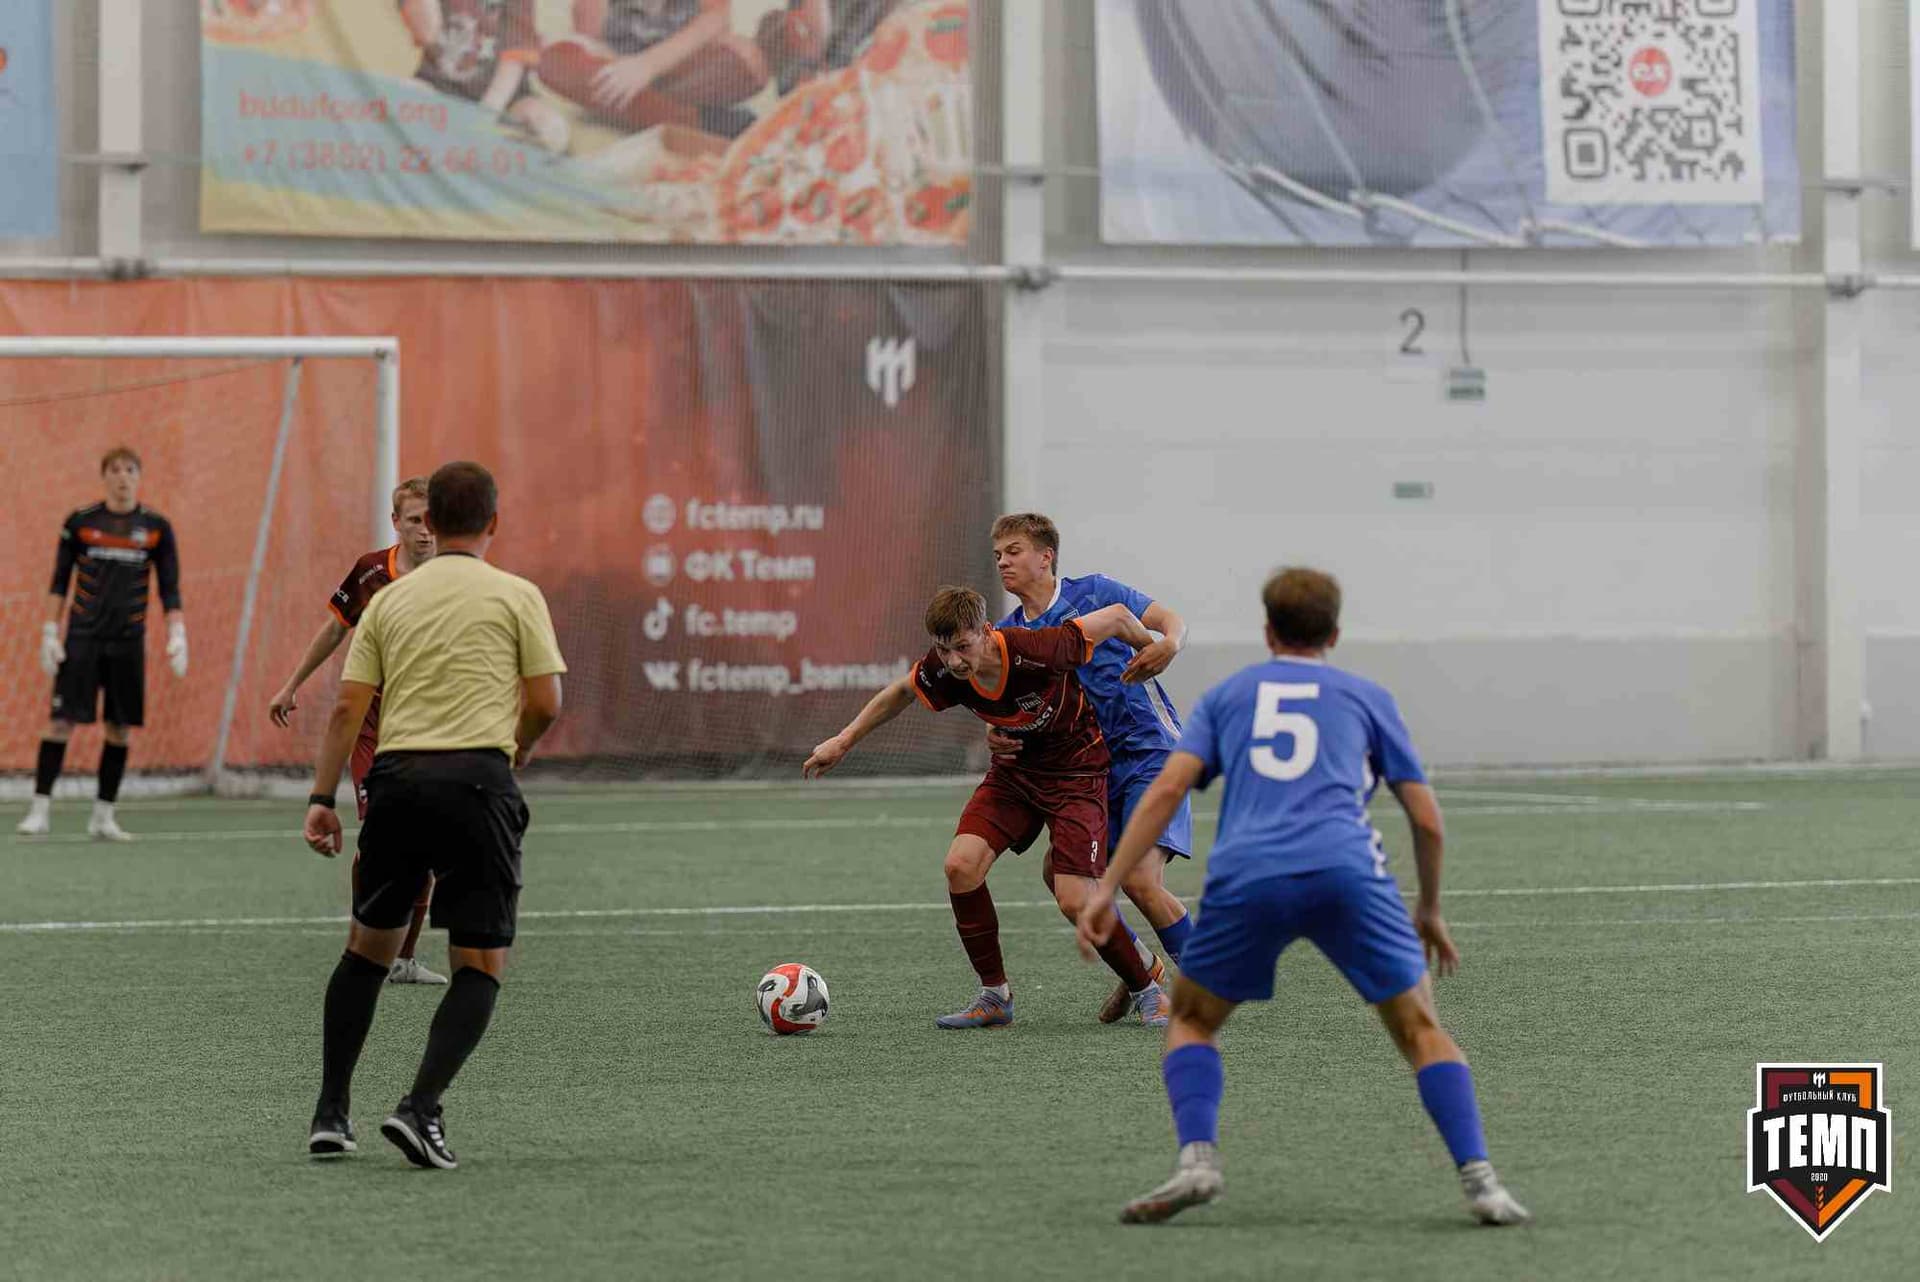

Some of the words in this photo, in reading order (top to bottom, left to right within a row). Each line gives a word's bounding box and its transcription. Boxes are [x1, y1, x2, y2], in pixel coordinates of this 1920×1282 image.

[1398, 306, 1426, 356] 2
[685, 496, 825, 536] fctemp.ru
[684, 551, 735, 581] ФК
[739, 550, 816, 581] Темп
[684, 603, 798, 641] fc.temp
[1249, 681, 1320, 782] 5
[1090, 839, 1099, 864] 3
